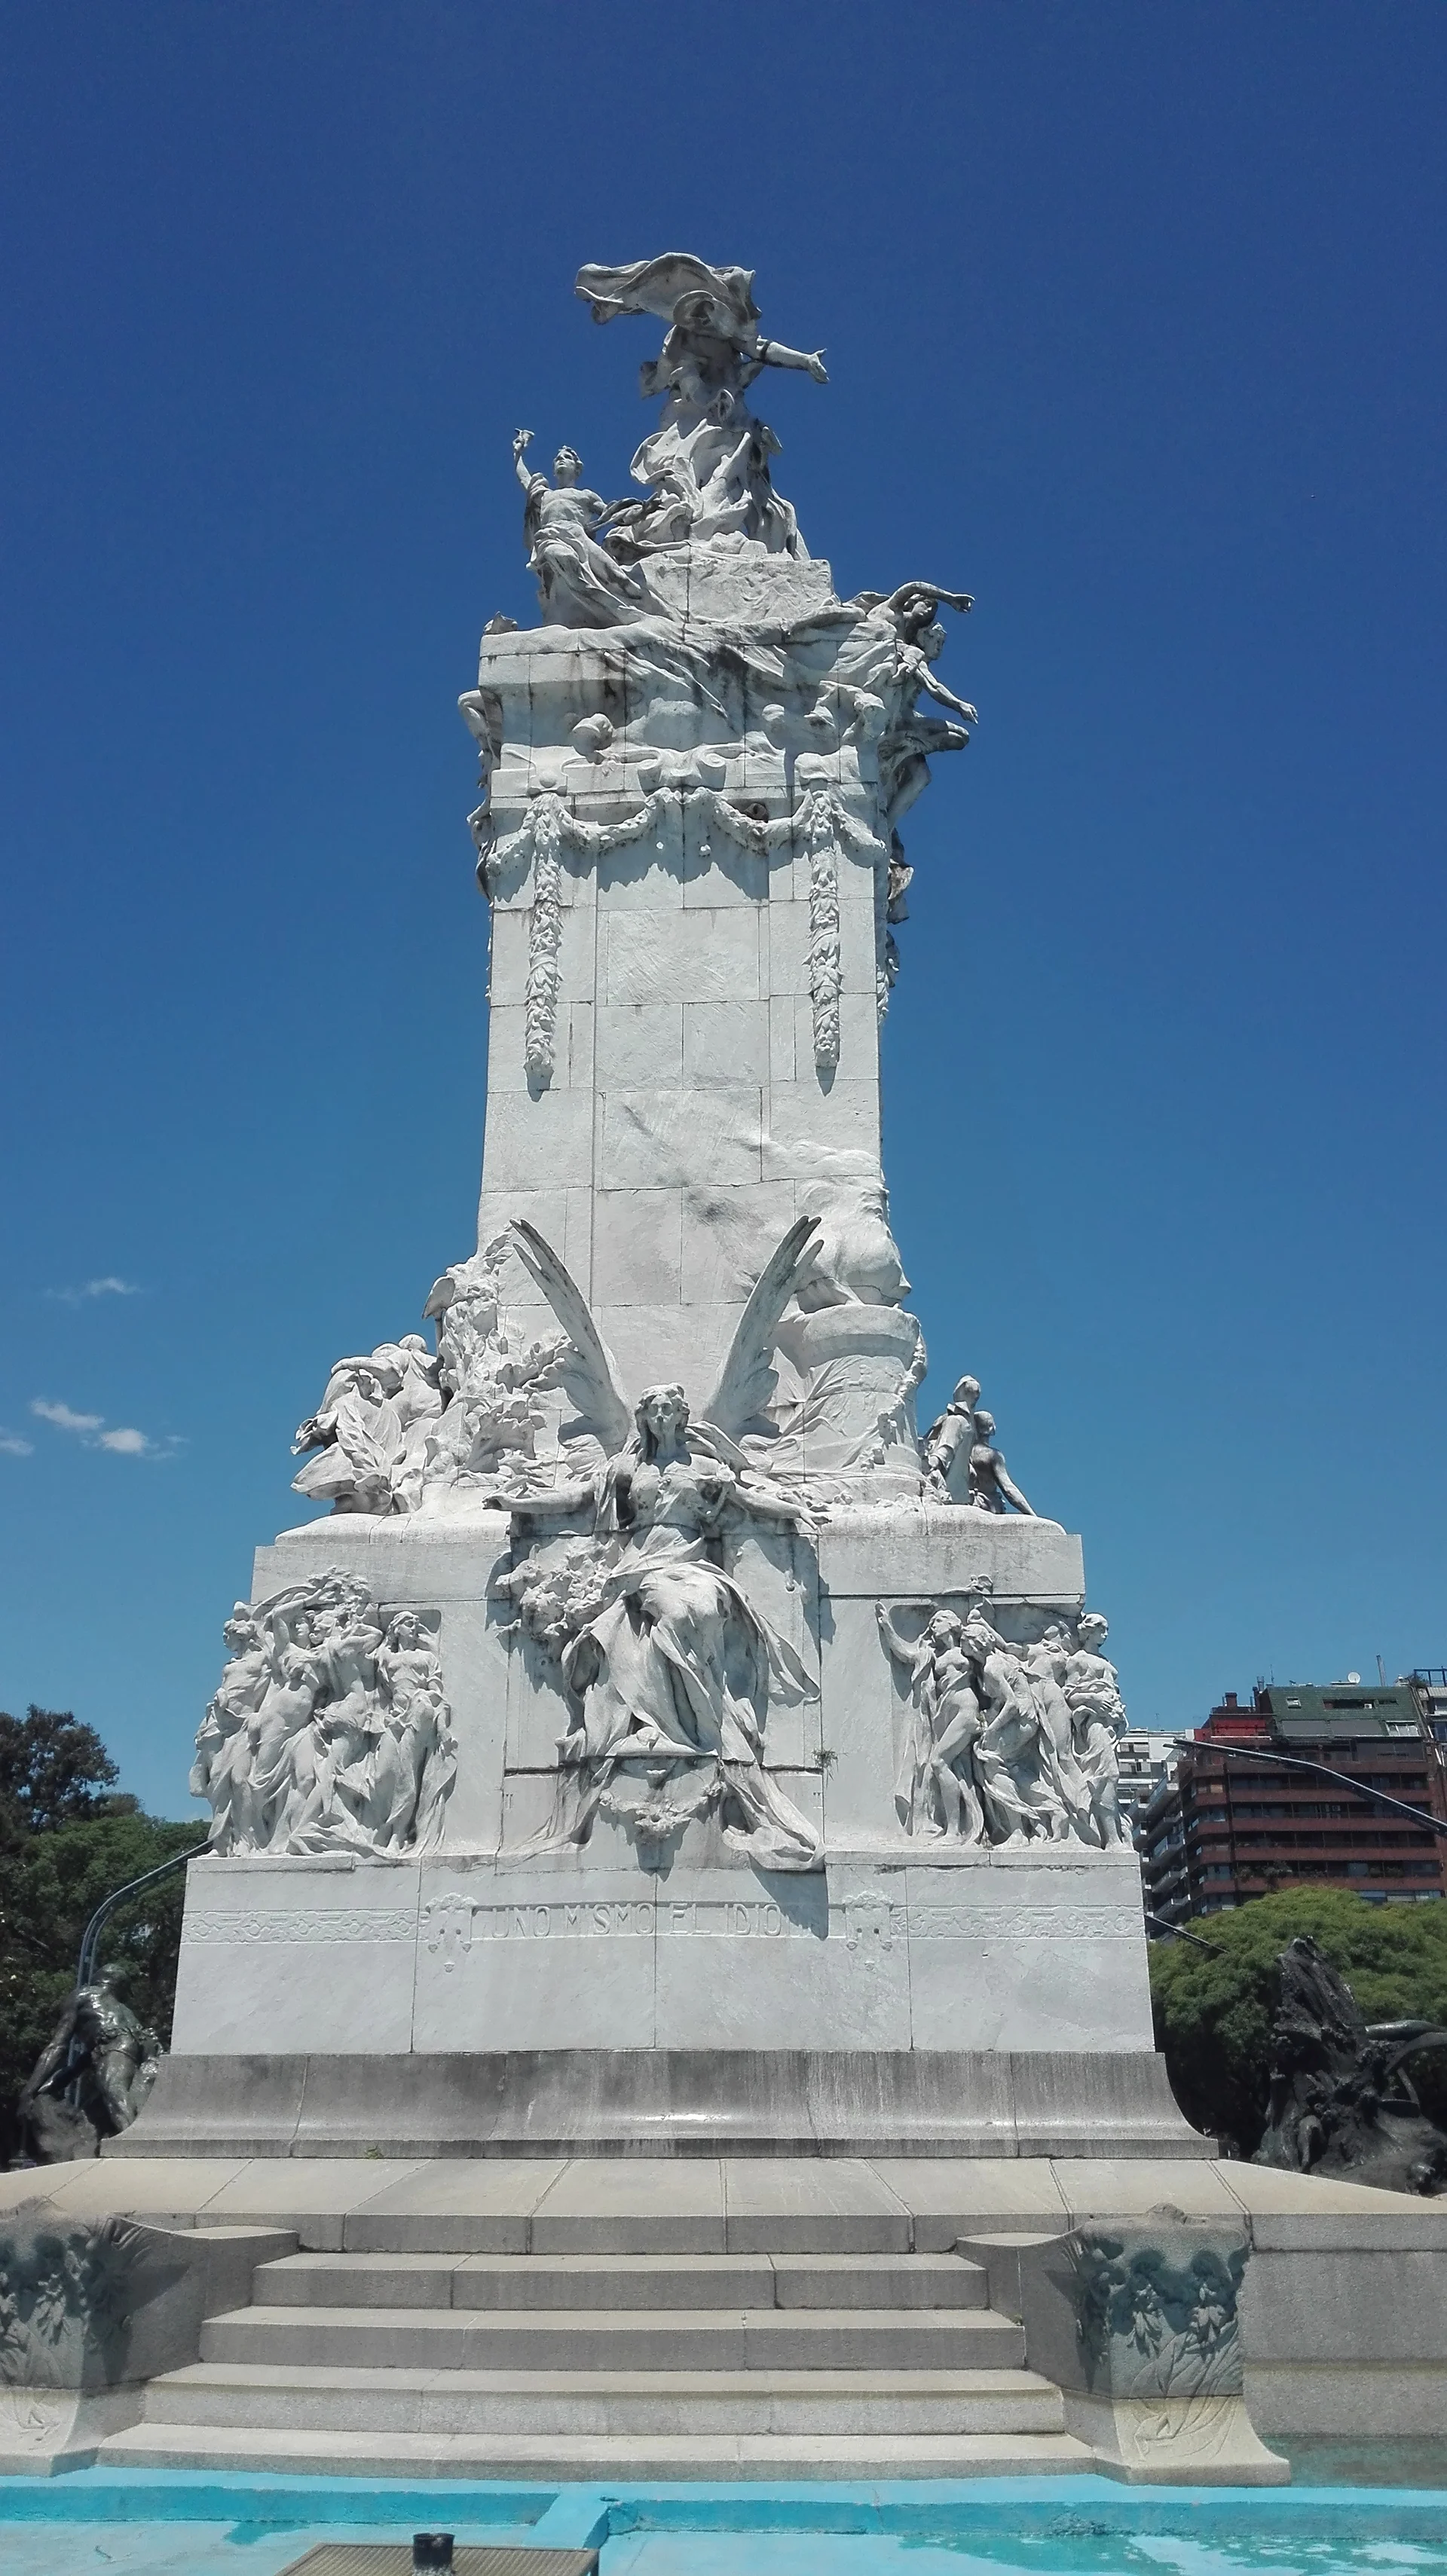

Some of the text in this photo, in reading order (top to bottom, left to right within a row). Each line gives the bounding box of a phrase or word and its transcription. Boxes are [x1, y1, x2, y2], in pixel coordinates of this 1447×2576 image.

[492, 1905, 550, 1938] UNO
[564, 1902, 653, 1936] MISMO
[670, 1902, 711, 1936] EL
